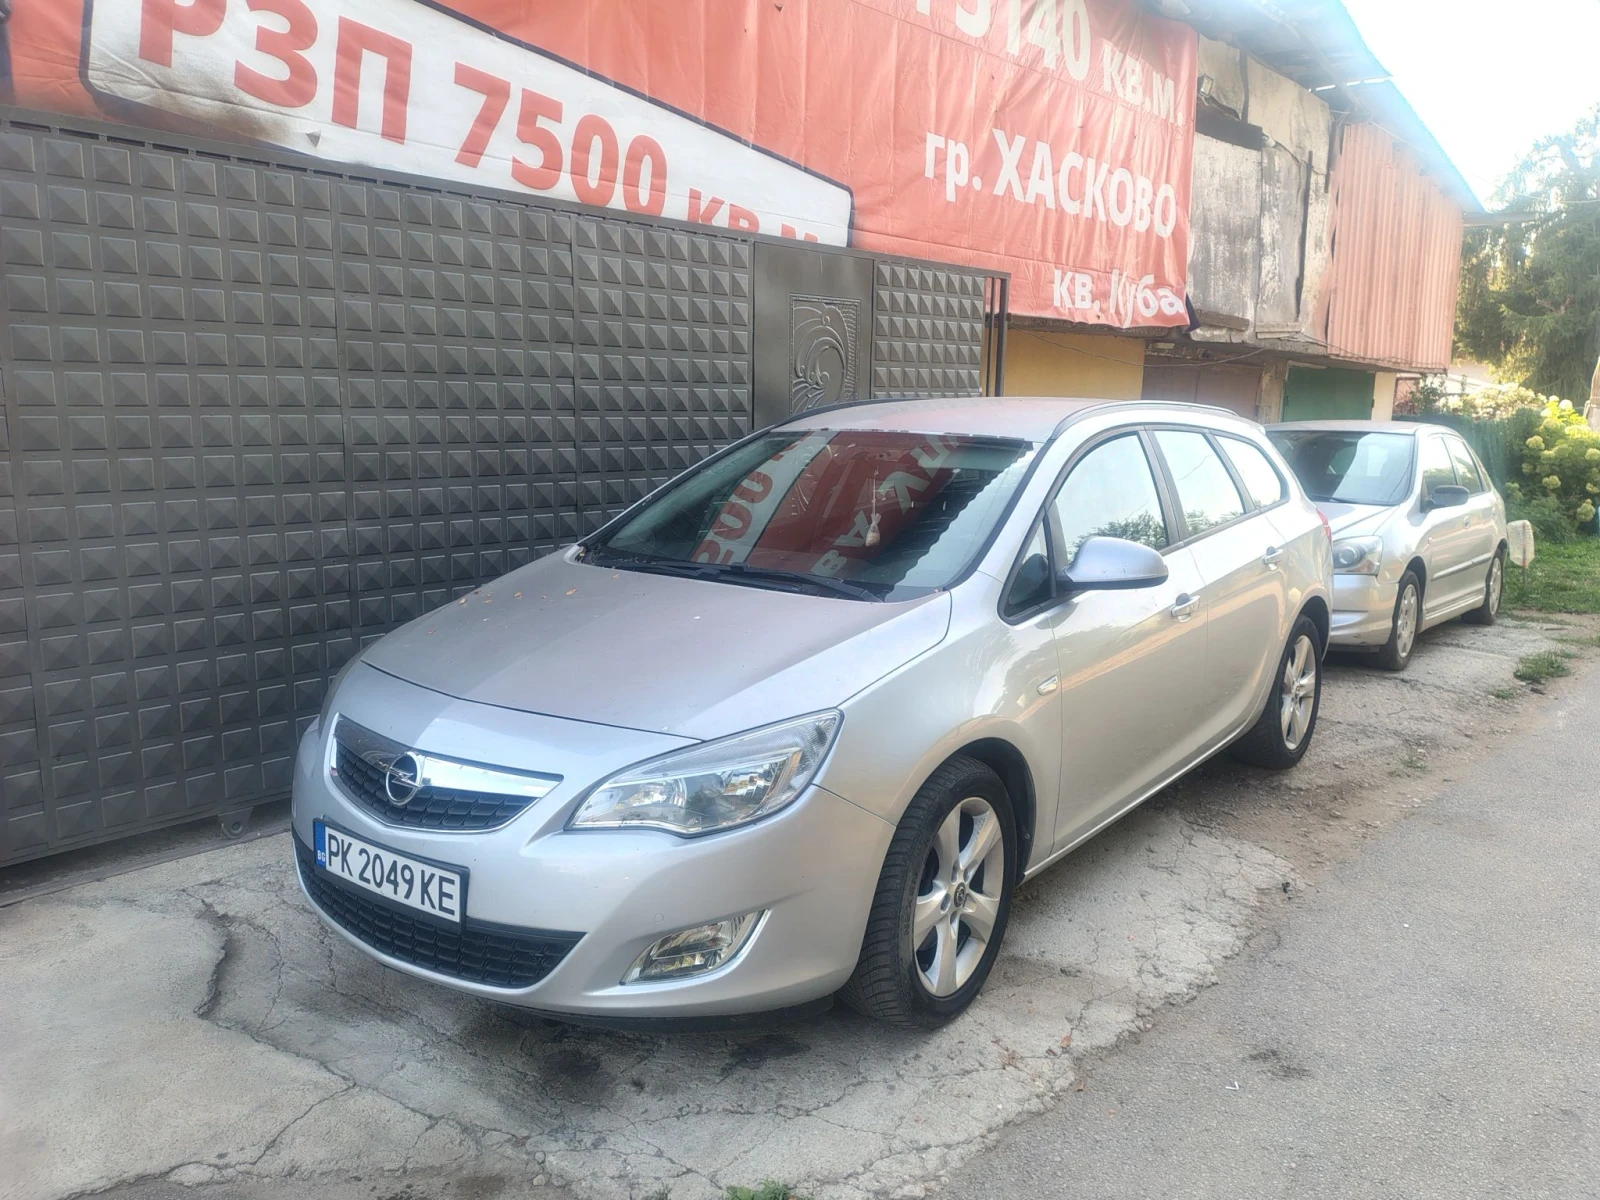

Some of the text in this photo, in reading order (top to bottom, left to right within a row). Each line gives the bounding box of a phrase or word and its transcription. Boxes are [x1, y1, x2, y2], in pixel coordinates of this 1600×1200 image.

[138, 0, 412, 146] РЗП
[454, 61, 668, 217] 7500
[925, 128, 1177, 238] гр. ХАСКОВО
[1110, 269, 1185, 329] Куба
[317, 850, 326, 863] BG
[328, 833, 456, 916] PK 2049 KE
